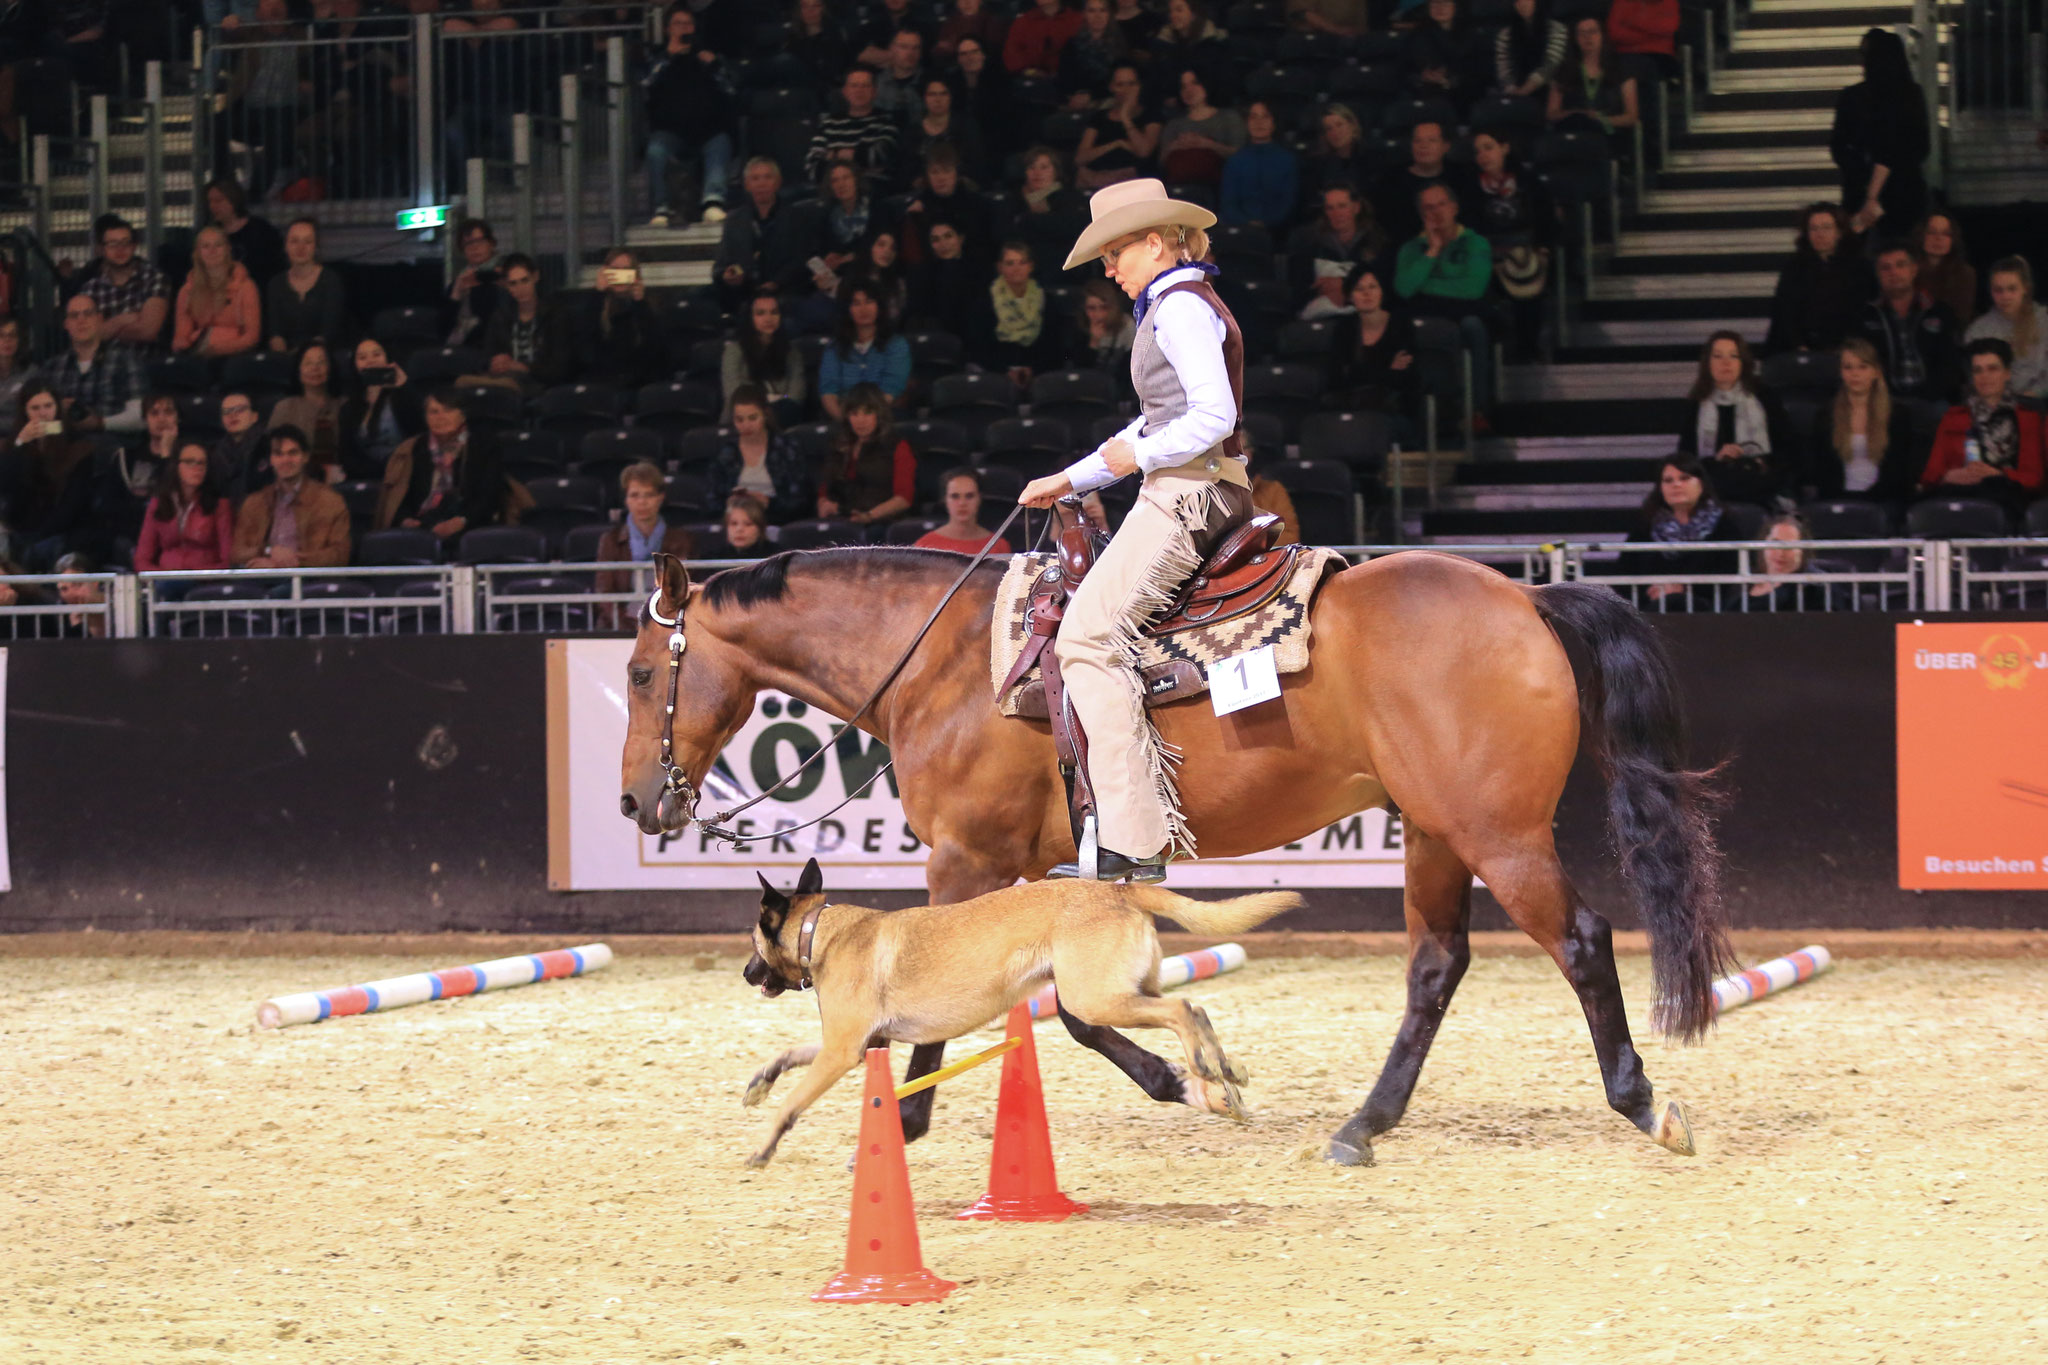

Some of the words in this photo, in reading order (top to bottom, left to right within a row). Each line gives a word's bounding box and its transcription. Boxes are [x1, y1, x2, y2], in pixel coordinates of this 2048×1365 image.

[1915, 649, 1977, 669] ÜBER
[1234, 658, 1249, 690] 1
[1925, 855, 2036, 873] Besuchen
